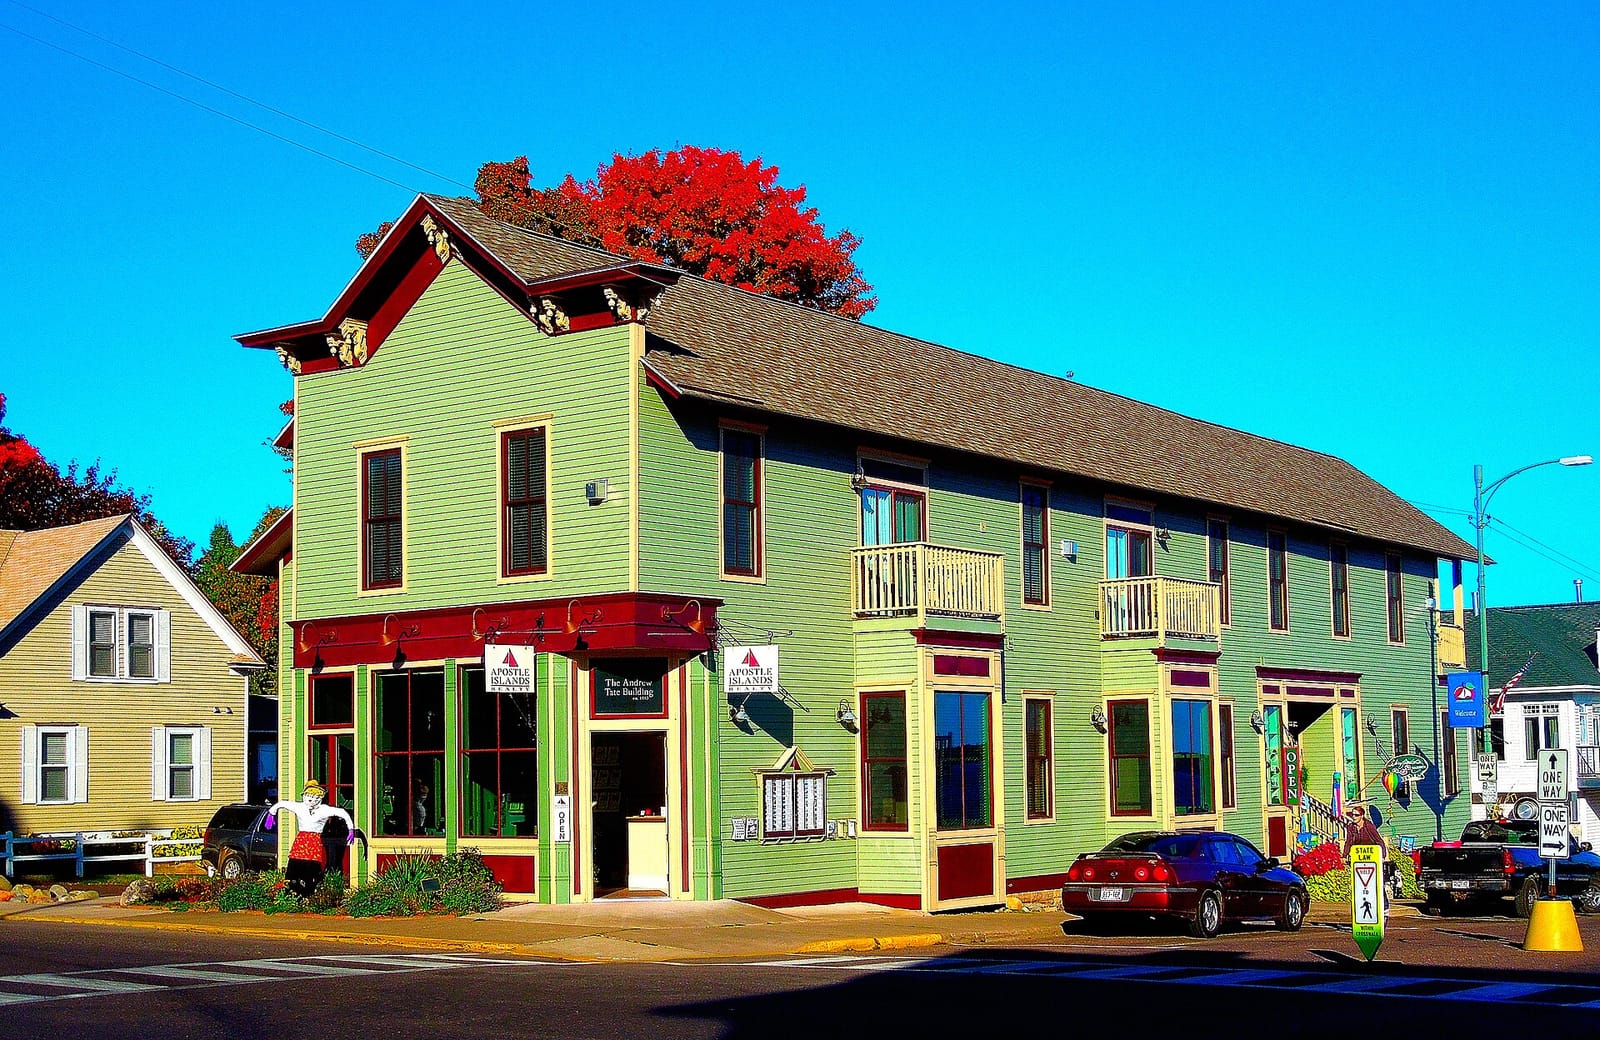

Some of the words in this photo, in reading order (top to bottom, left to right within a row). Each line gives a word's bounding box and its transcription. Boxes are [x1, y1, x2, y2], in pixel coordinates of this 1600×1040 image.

[490, 668, 530, 677] APOSTLE
[729, 667, 773, 676] APOSTLE
[490, 676, 530, 685] ISLANDS
[604, 678, 621, 687] The
[622, 678, 653, 687] Andrew
[729, 676, 773, 685] ISLANDS
[604, 687, 621, 696] Tate
[622, 687, 655, 698] Building
[1480, 755, 1495, 763] ONE
[1286, 752, 1298, 799] OPEN
[1542, 771, 1562, 783] ONE
[1542, 786, 1562, 798] WAY
[1544, 809, 1566, 822] ONE
[558, 811, 566, 840] OPEN
[1543, 824, 1567, 837] WAY
